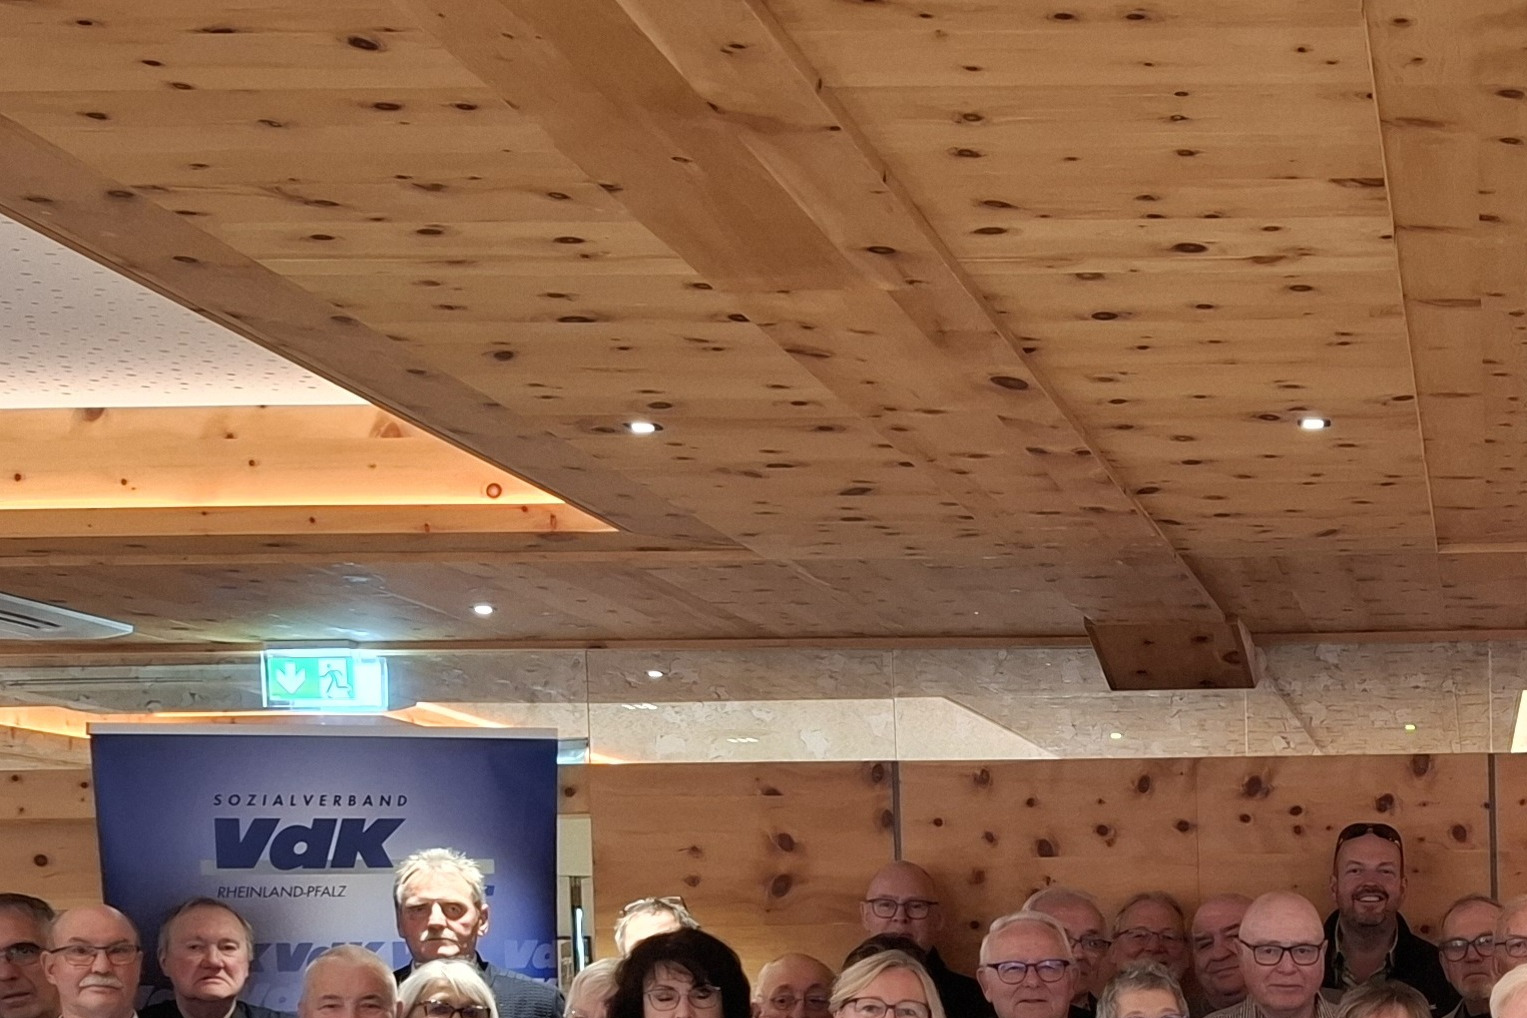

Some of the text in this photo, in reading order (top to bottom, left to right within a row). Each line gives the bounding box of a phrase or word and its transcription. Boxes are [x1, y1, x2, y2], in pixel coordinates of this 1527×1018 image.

[213, 794, 409, 808] SOZIALVERBAND
[213, 817, 407, 872] VdK
[217, 885, 348, 899] RHEINLAND-PFALZ
